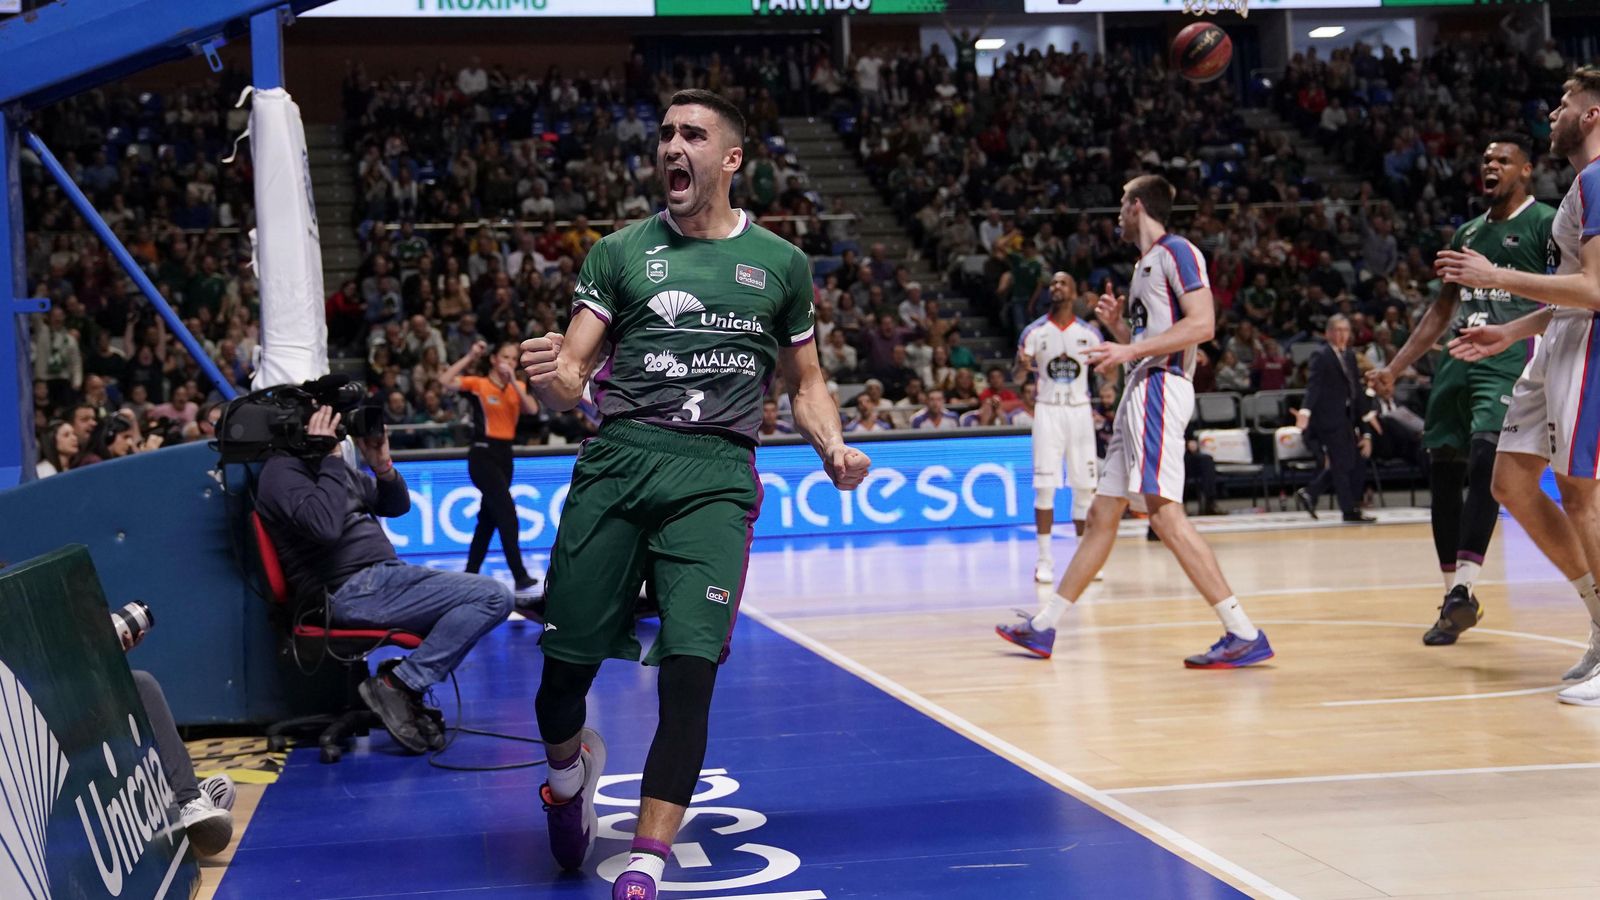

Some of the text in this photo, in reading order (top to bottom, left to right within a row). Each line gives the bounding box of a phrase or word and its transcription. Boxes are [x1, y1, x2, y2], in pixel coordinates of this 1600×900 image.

[701, 311, 764, 333] Unicaja
[1467, 311, 1489, 328] 15
[691, 349, 756, 371] MÁLAGA
[671, 389, 705, 422] 3
[708, 592, 724, 601] acb
[74, 713, 174, 897] Unicaja
